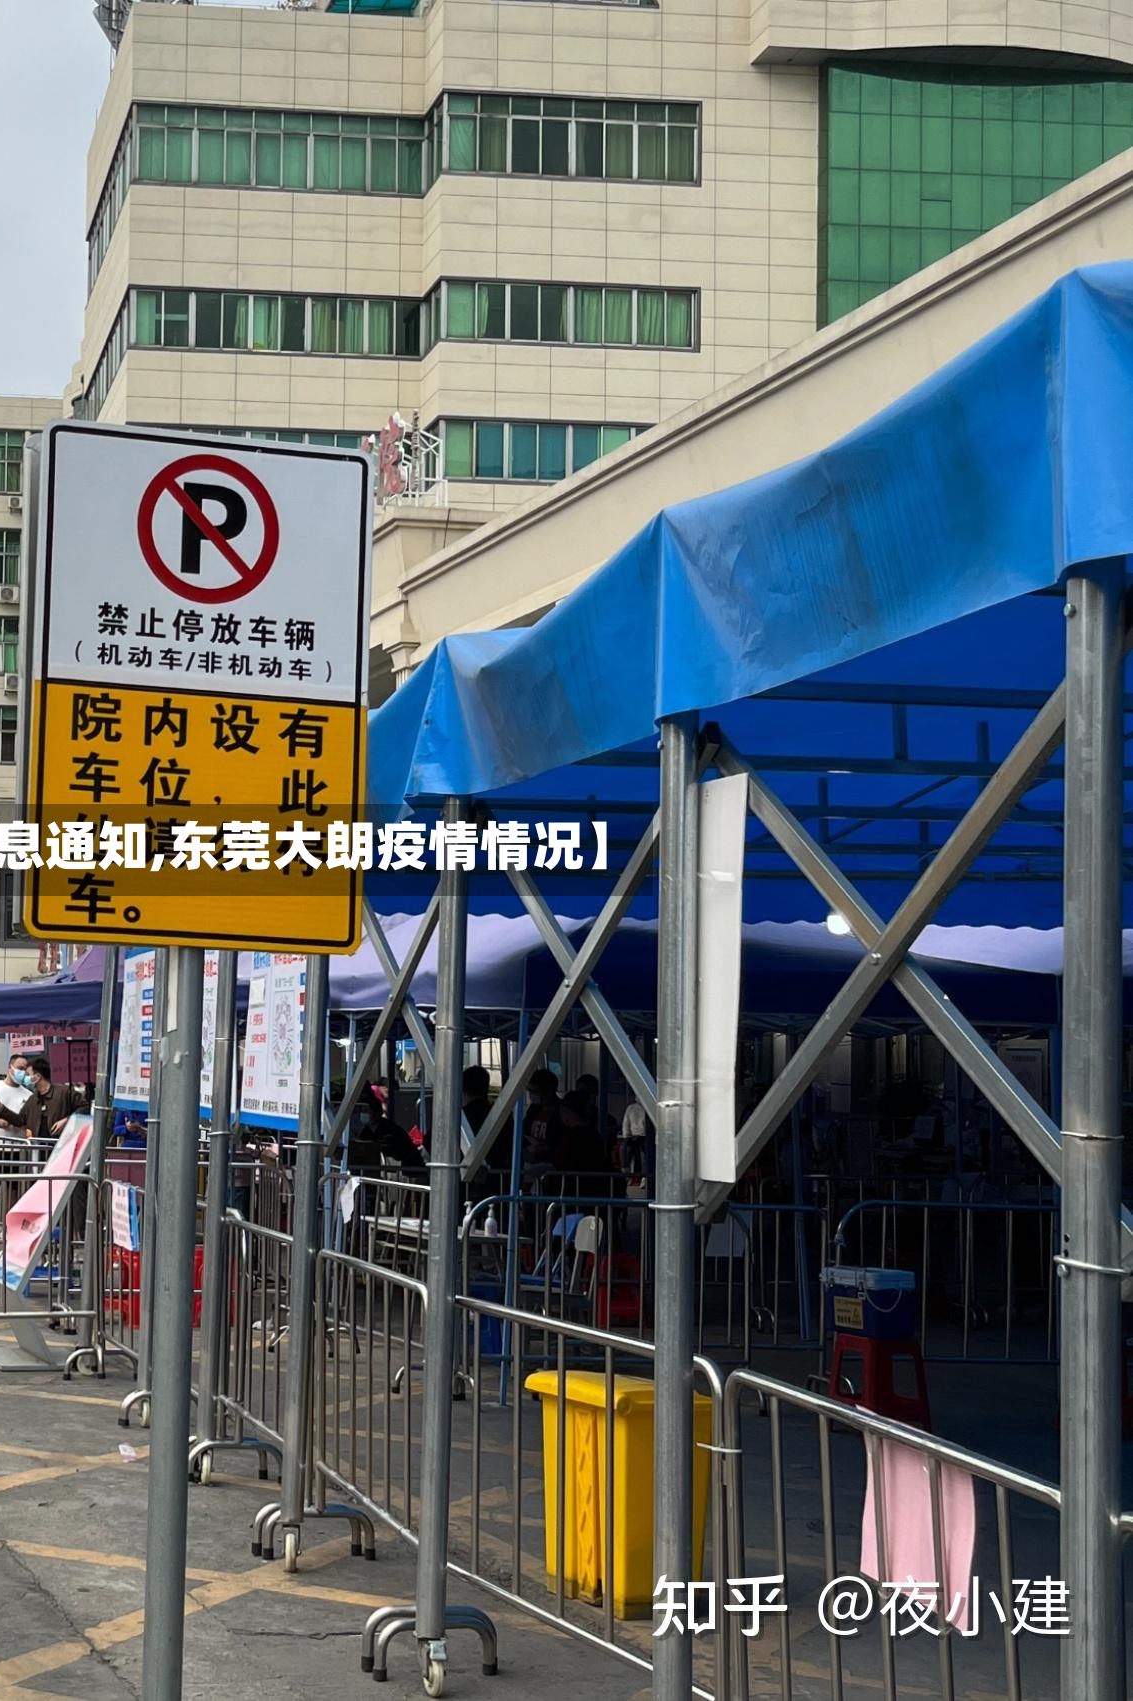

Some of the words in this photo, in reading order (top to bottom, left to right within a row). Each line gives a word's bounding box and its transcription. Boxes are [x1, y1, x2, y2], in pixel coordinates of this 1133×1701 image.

[97, 601, 316, 652] 禁止停放车辆
[70, 692, 330, 759] 院内设有
